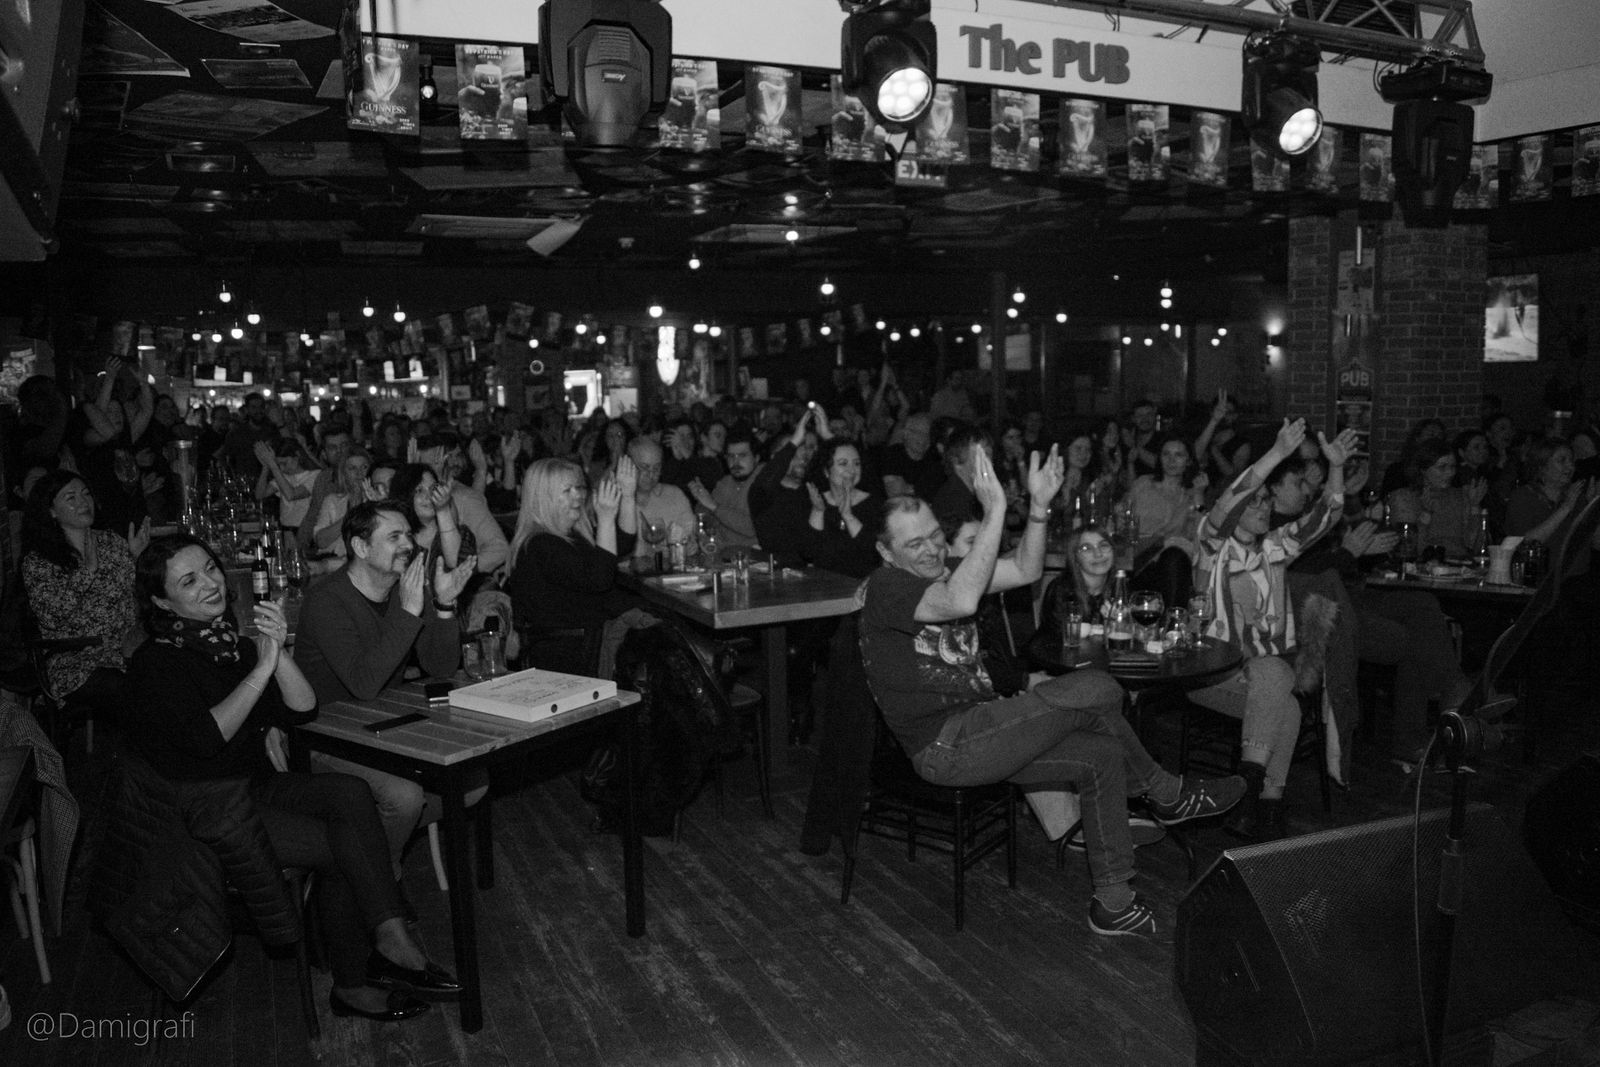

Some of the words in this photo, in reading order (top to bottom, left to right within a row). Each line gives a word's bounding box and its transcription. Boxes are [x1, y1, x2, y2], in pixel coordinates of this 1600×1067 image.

[959, 23, 1042, 75] The
[1052, 37, 1131, 84] PUB
[360, 101, 407, 114] GUINNESS
[1340, 370, 1369, 386] PUB
